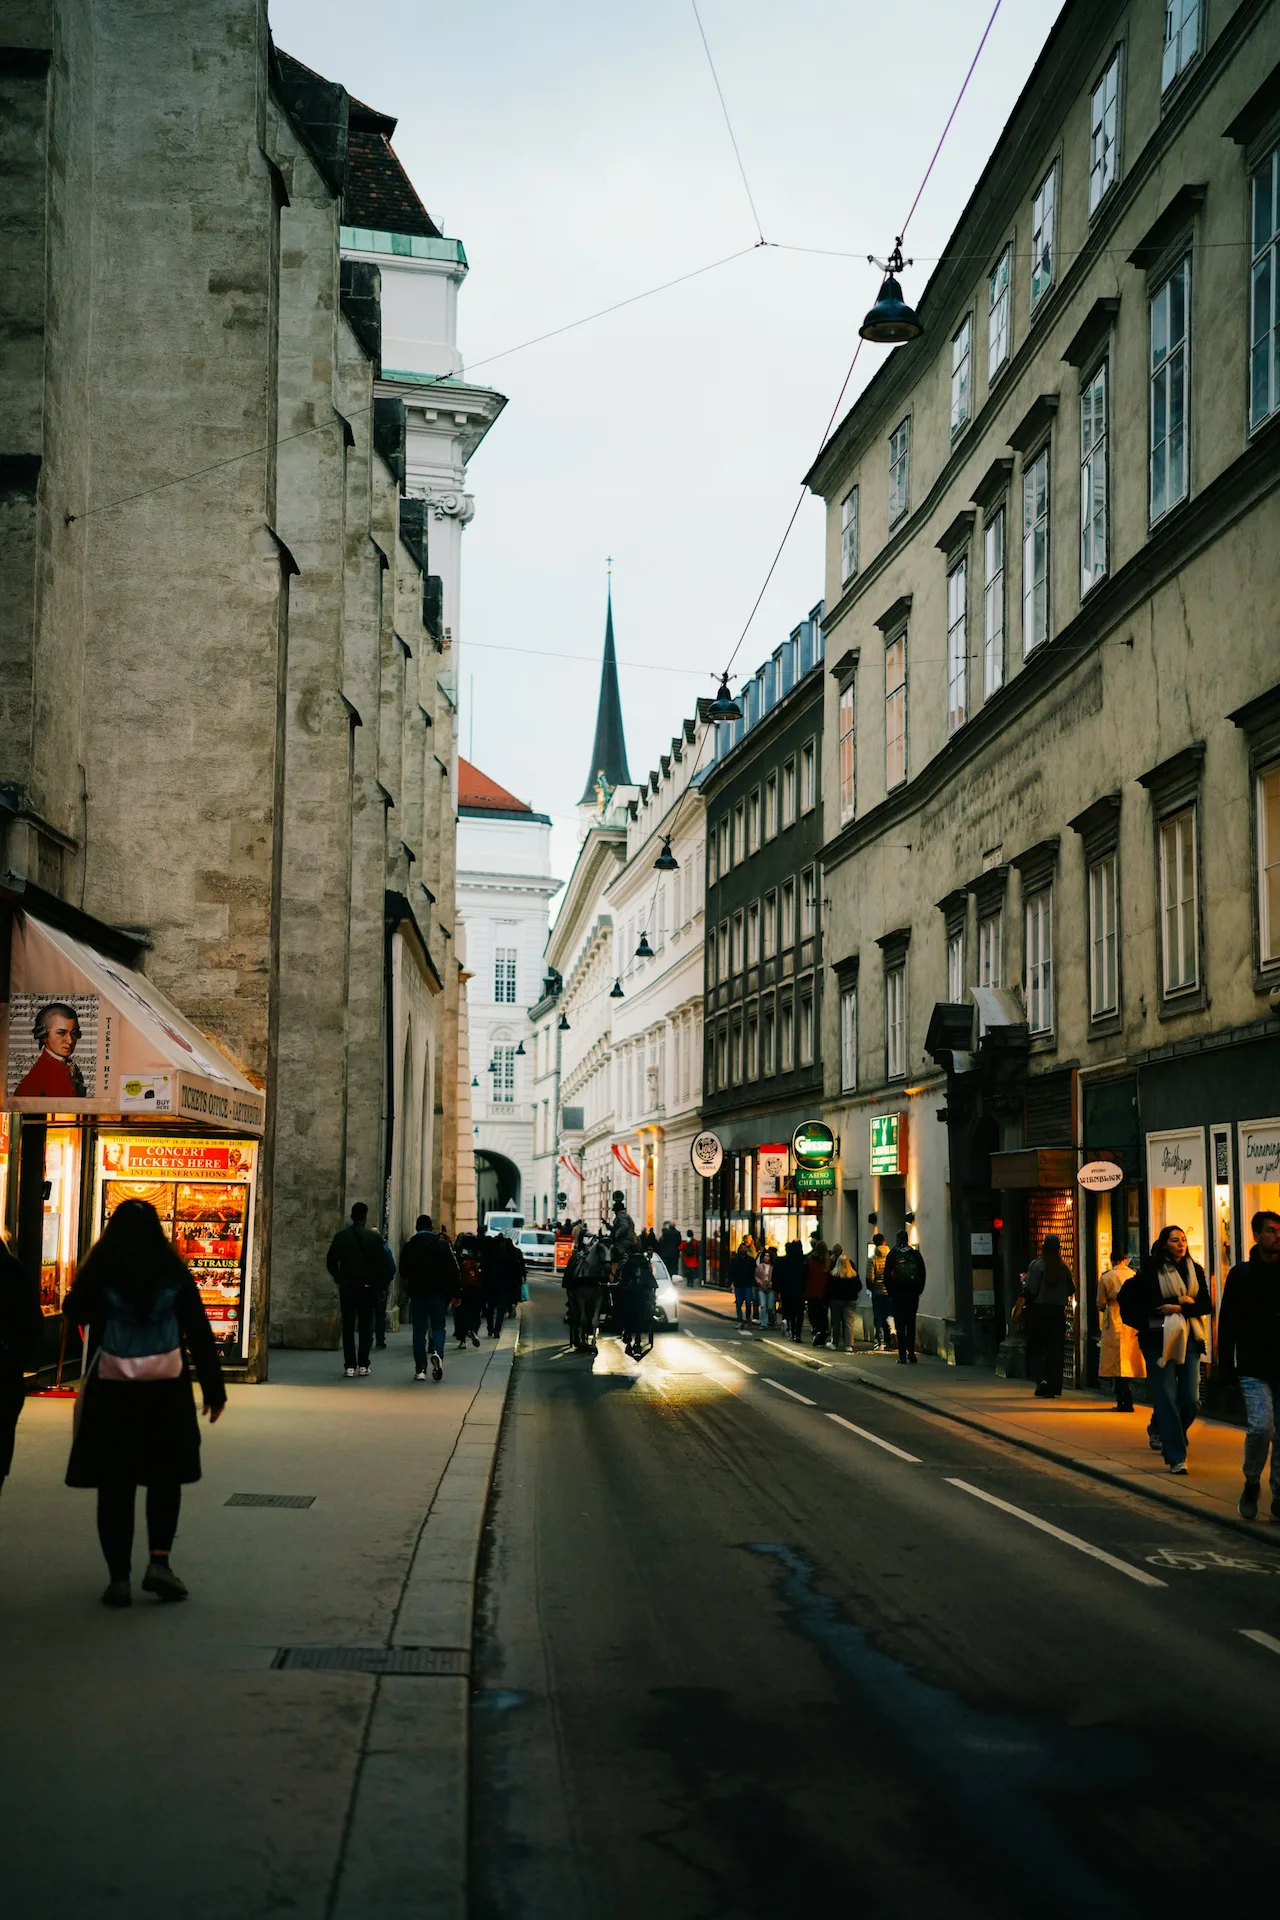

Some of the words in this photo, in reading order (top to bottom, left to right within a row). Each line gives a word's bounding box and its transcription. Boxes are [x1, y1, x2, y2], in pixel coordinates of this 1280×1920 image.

[181, 1085, 207, 1113] TICKETS
[208, 1094, 229, 1119] OFFICE
[146, 1146, 206, 1157] CONCERT
[130, 1157, 184, 1167] TICKETS
[187, 1158, 221, 1168] HERE
[160, 1169, 228, 1178] RESERVATIONS
[187, 1260, 196, 1268] &
[197, 1260, 239, 1268] STRAUSS
